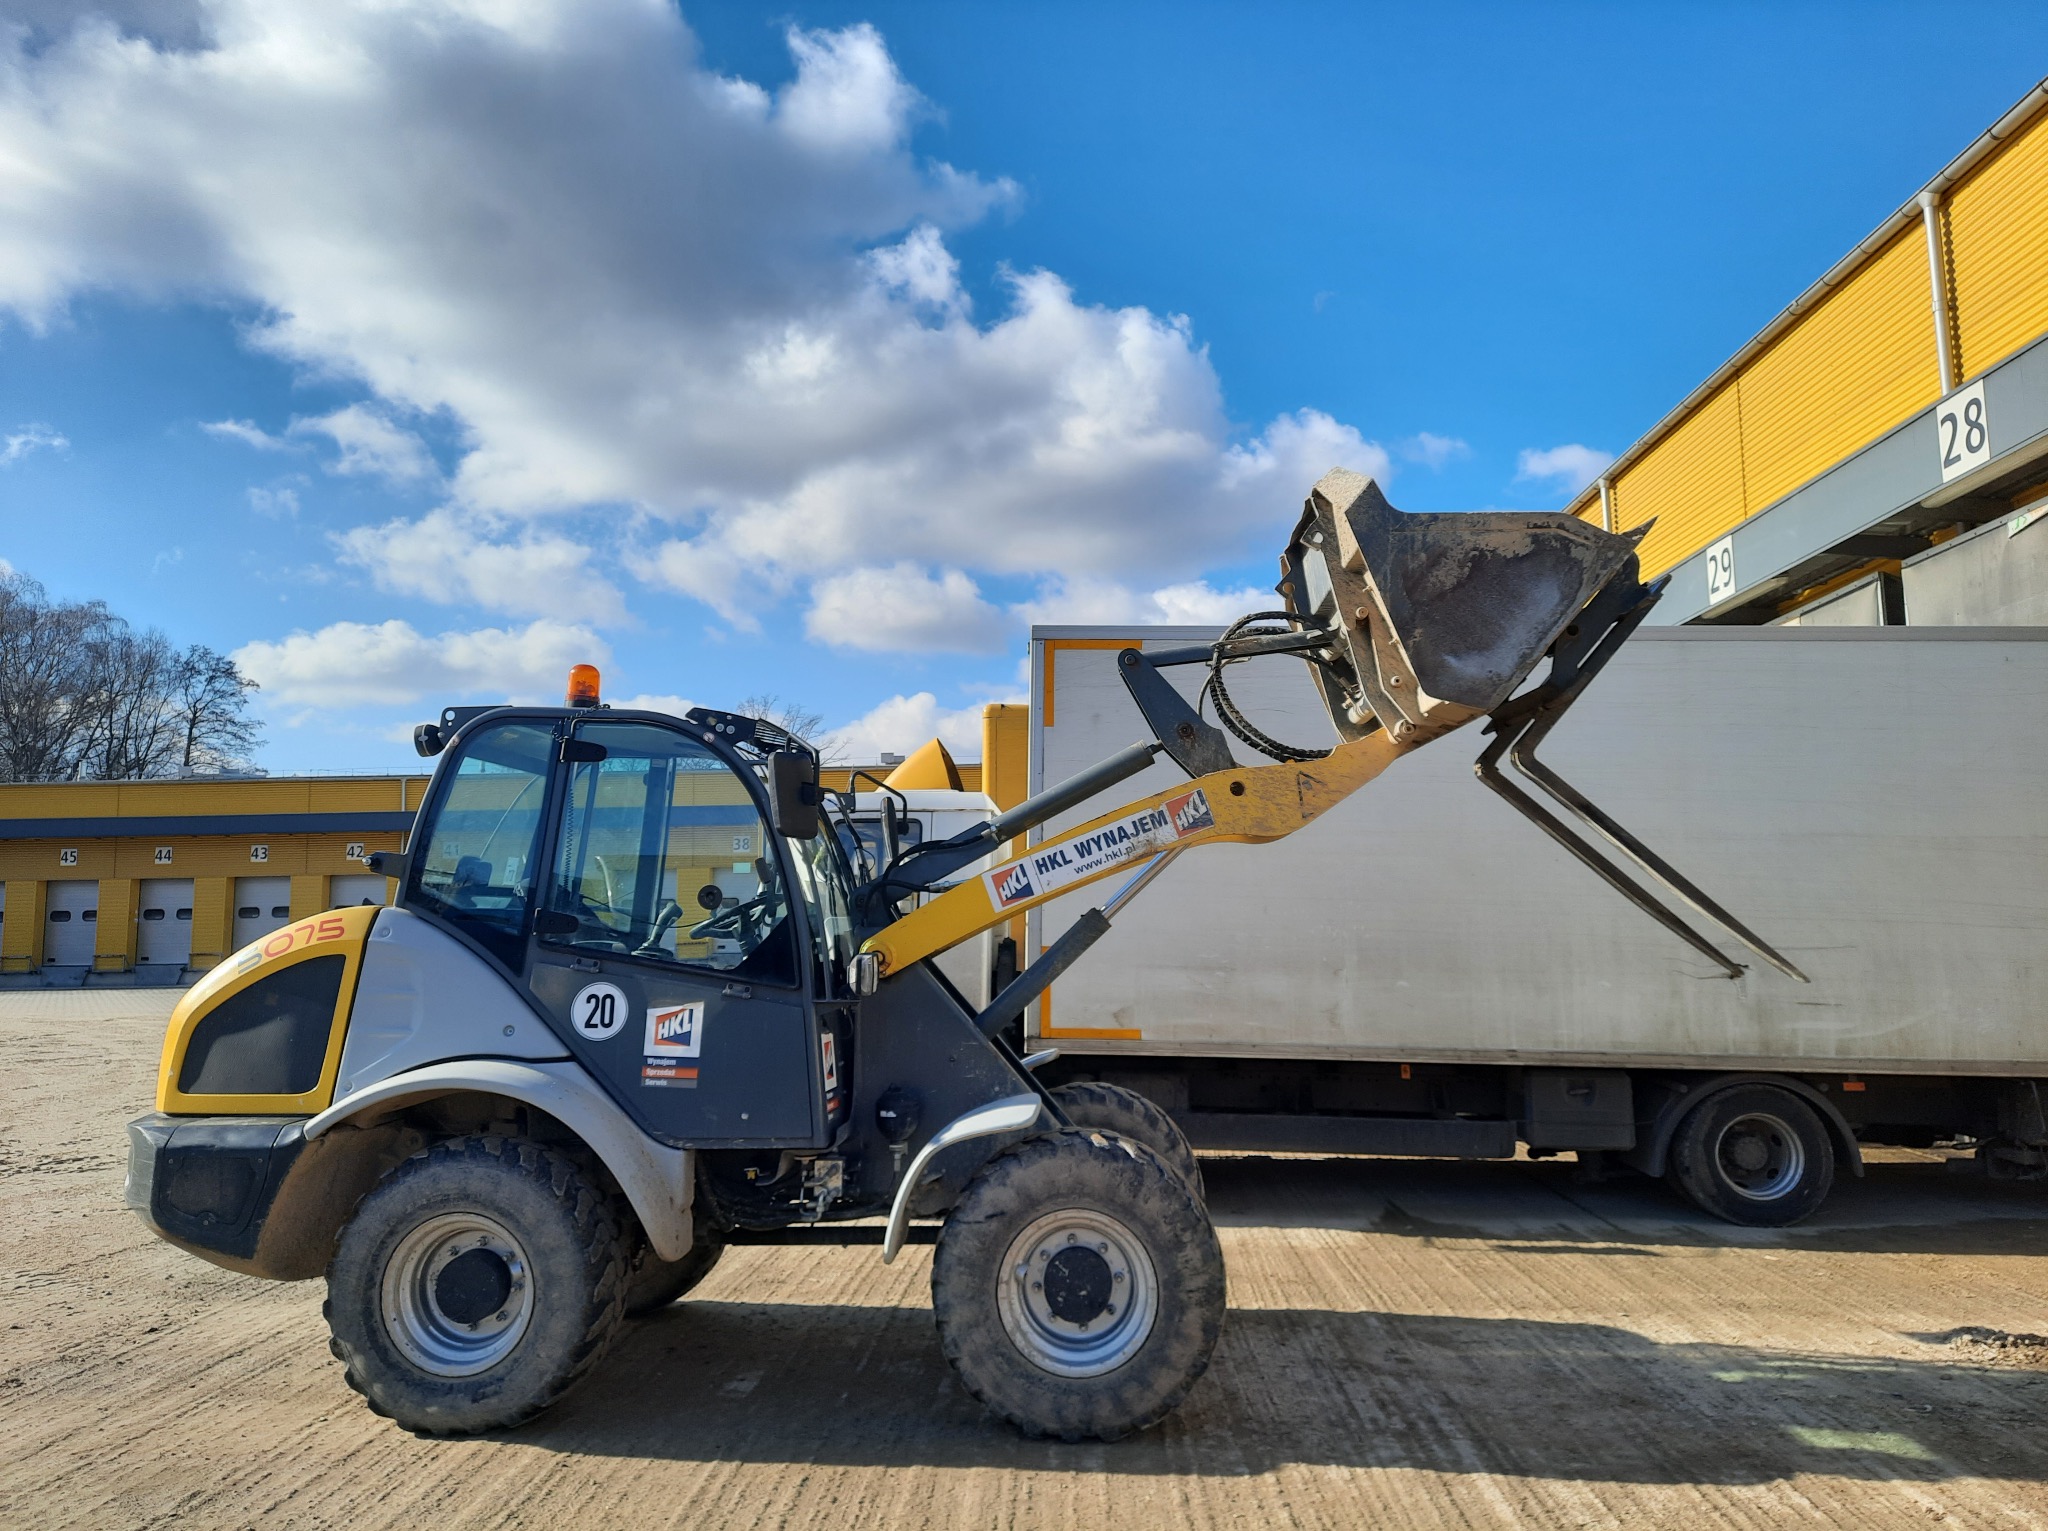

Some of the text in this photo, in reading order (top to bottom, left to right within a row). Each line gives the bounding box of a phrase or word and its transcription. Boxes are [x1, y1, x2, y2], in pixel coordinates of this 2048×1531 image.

[1940, 397, 1986, 469] 28
[1708, 547, 1732, 594] 29
[1175, 790, 1208, 832] HKL
[60, 850, 77, 863] 45
[155, 847, 172, 862] 44
[250, 846, 268, 860] 43
[346, 845, 364, 858] 42
[733, 837, 750, 850] 38
[1034, 809, 1169, 876] HKL WYNAJEM
[1073, 842, 1137, 875] www.hkl.pl
[999, 863, 1029, 902] HKL
[237, 917, 345, 975] 5075
[584, 993, 616, 1029] 20
[656, 1008, 693, 1041] HKL
